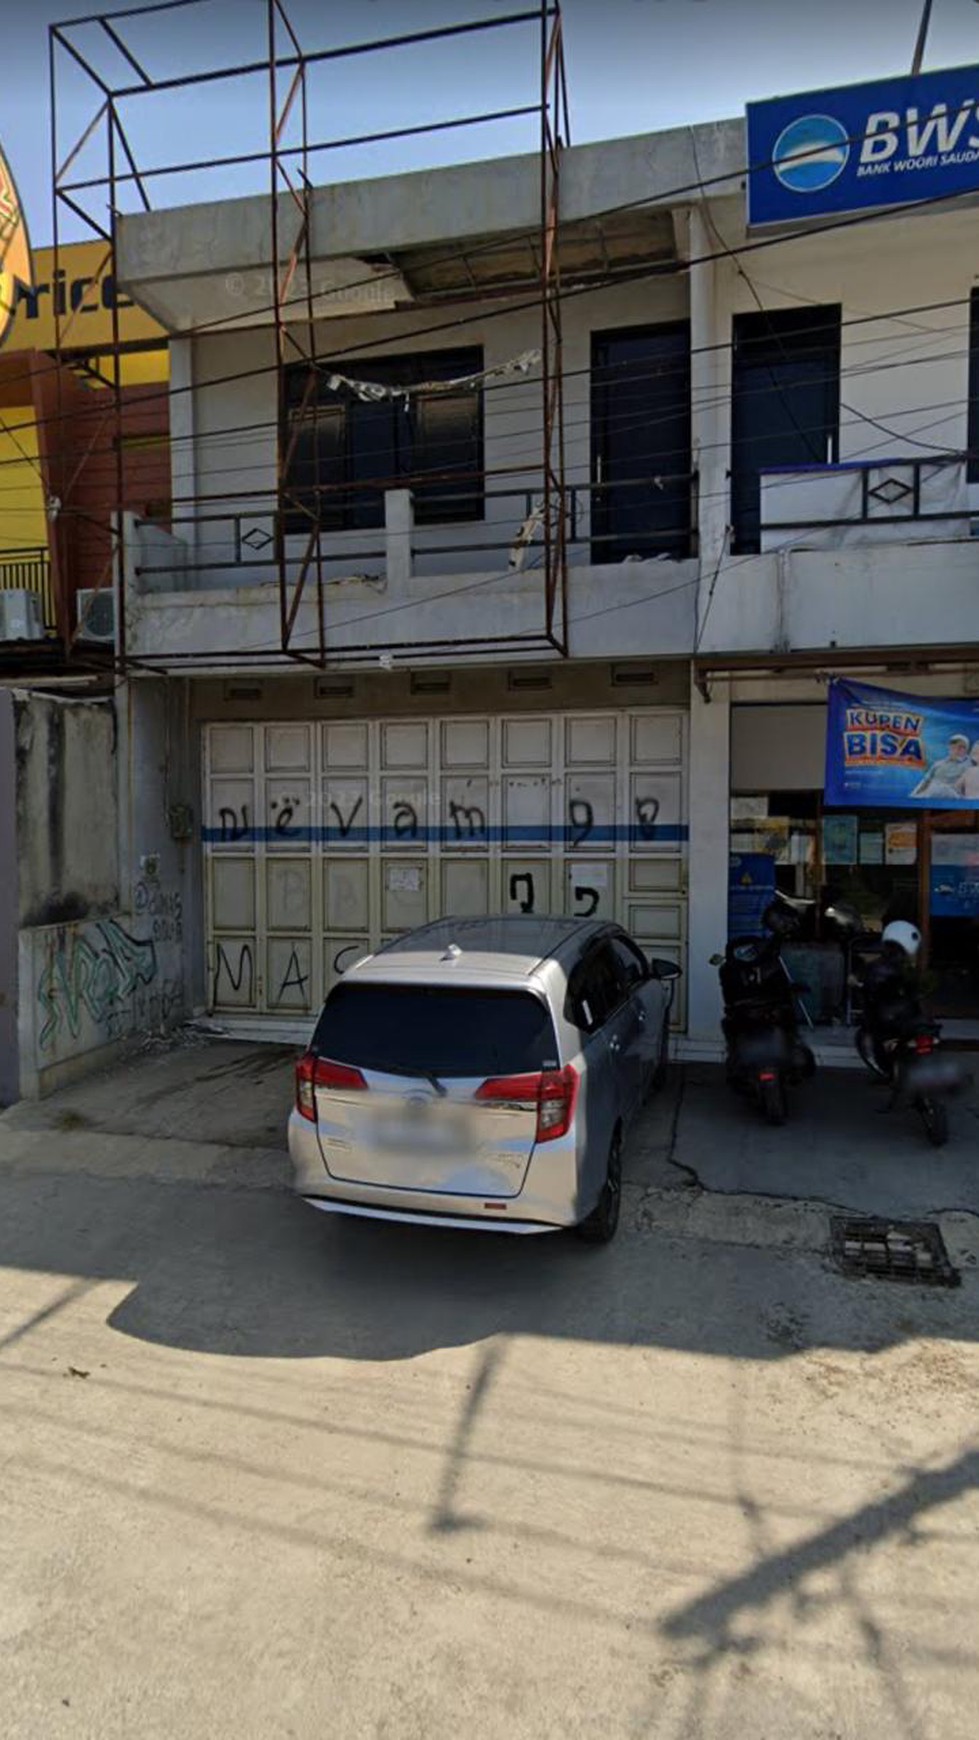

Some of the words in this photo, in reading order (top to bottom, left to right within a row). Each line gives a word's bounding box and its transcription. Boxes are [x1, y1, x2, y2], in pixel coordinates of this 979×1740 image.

[857, 163, 891, 177] BANK
[894, 156, 938, 172] WOORI
[849, 711, 920, 732] KUPEN
[846, 733, 923, 761] BISA
